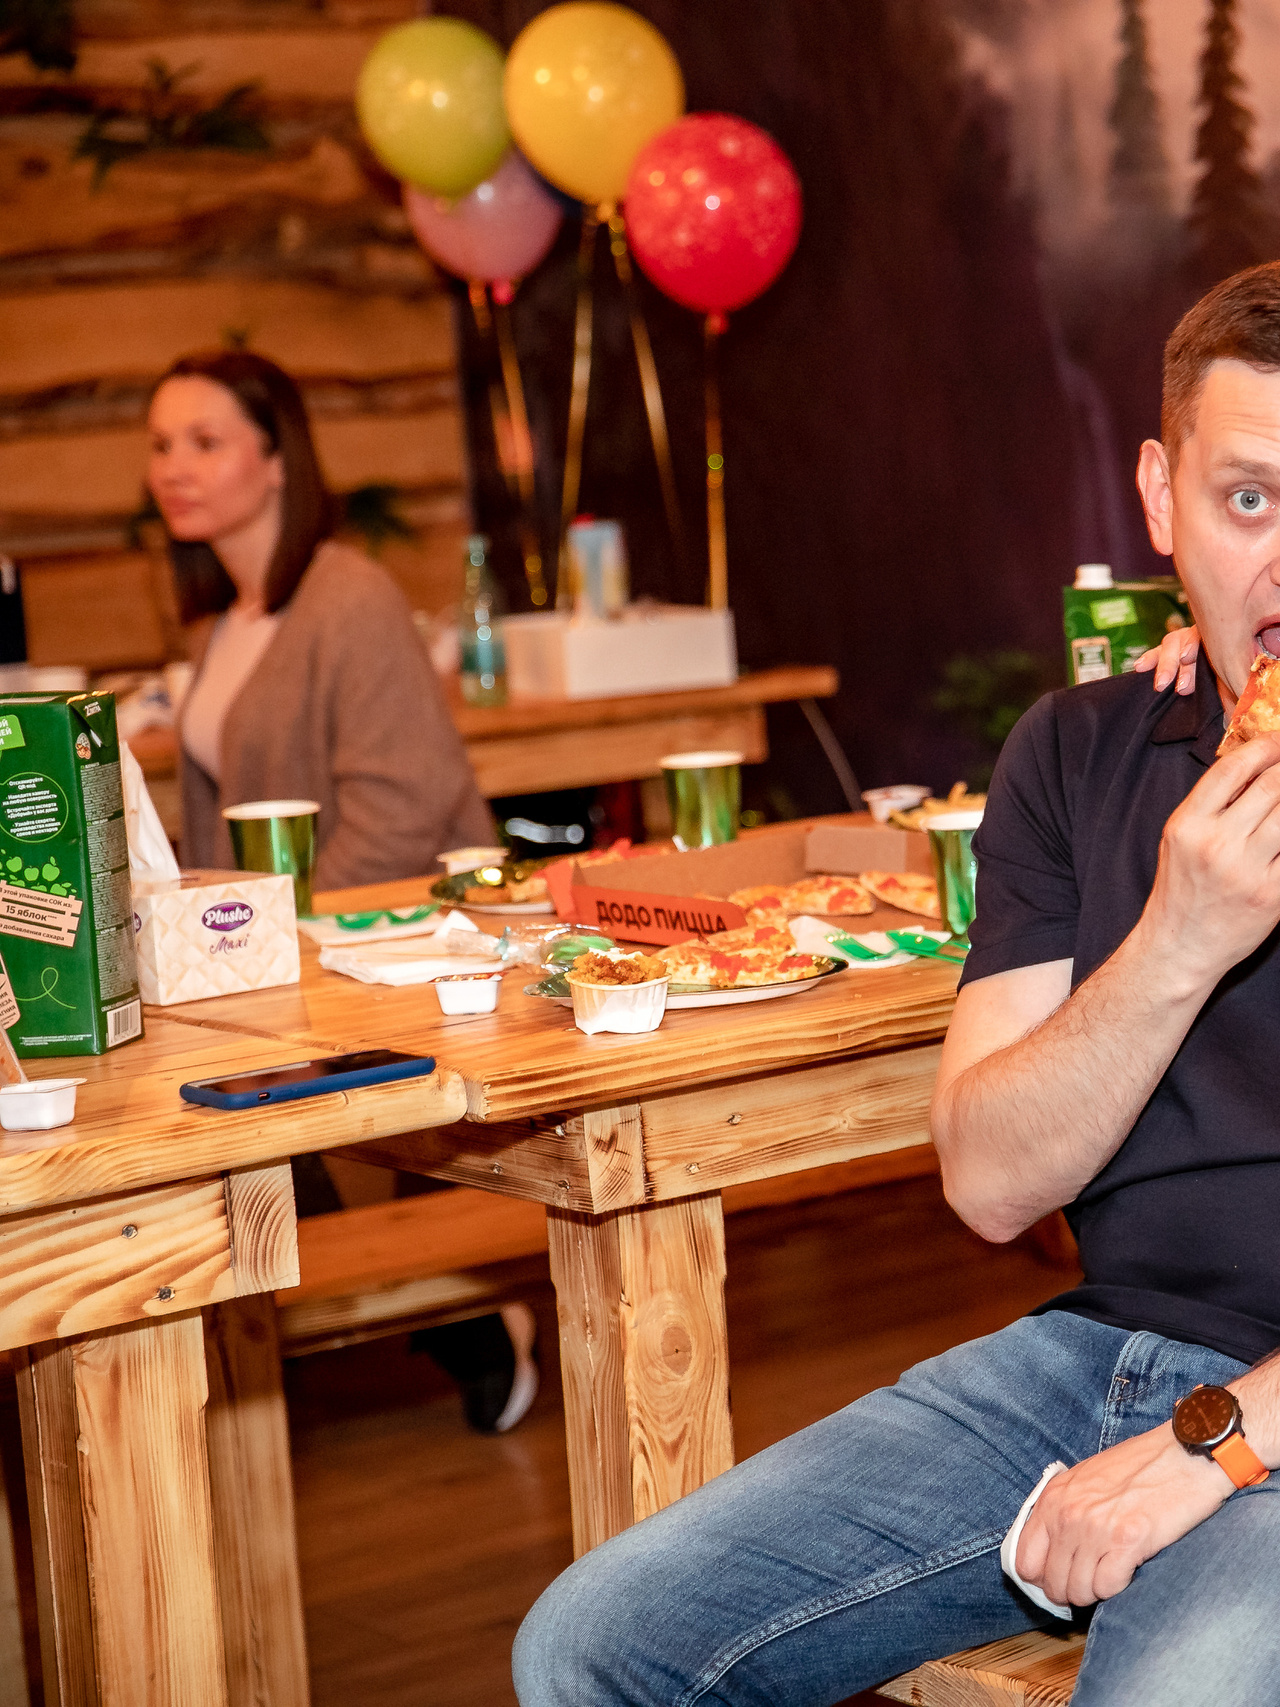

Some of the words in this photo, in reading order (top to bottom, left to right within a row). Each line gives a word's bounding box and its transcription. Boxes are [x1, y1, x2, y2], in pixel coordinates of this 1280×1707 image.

[19, 892, 49, 903] упаковке
[49, 898, 63, 906] СОК
[6, 904, 16, 914] 15
[204, 905, 252, 927] Plushe
[596, 900, 652, 931] ДОДО
[653, 907, 729, 935] ПИЦЦА
[3, 924, 42, 936] добавления
[42, 932, 65, 941] сахара
[209, 934, 250, 955] Maxi
